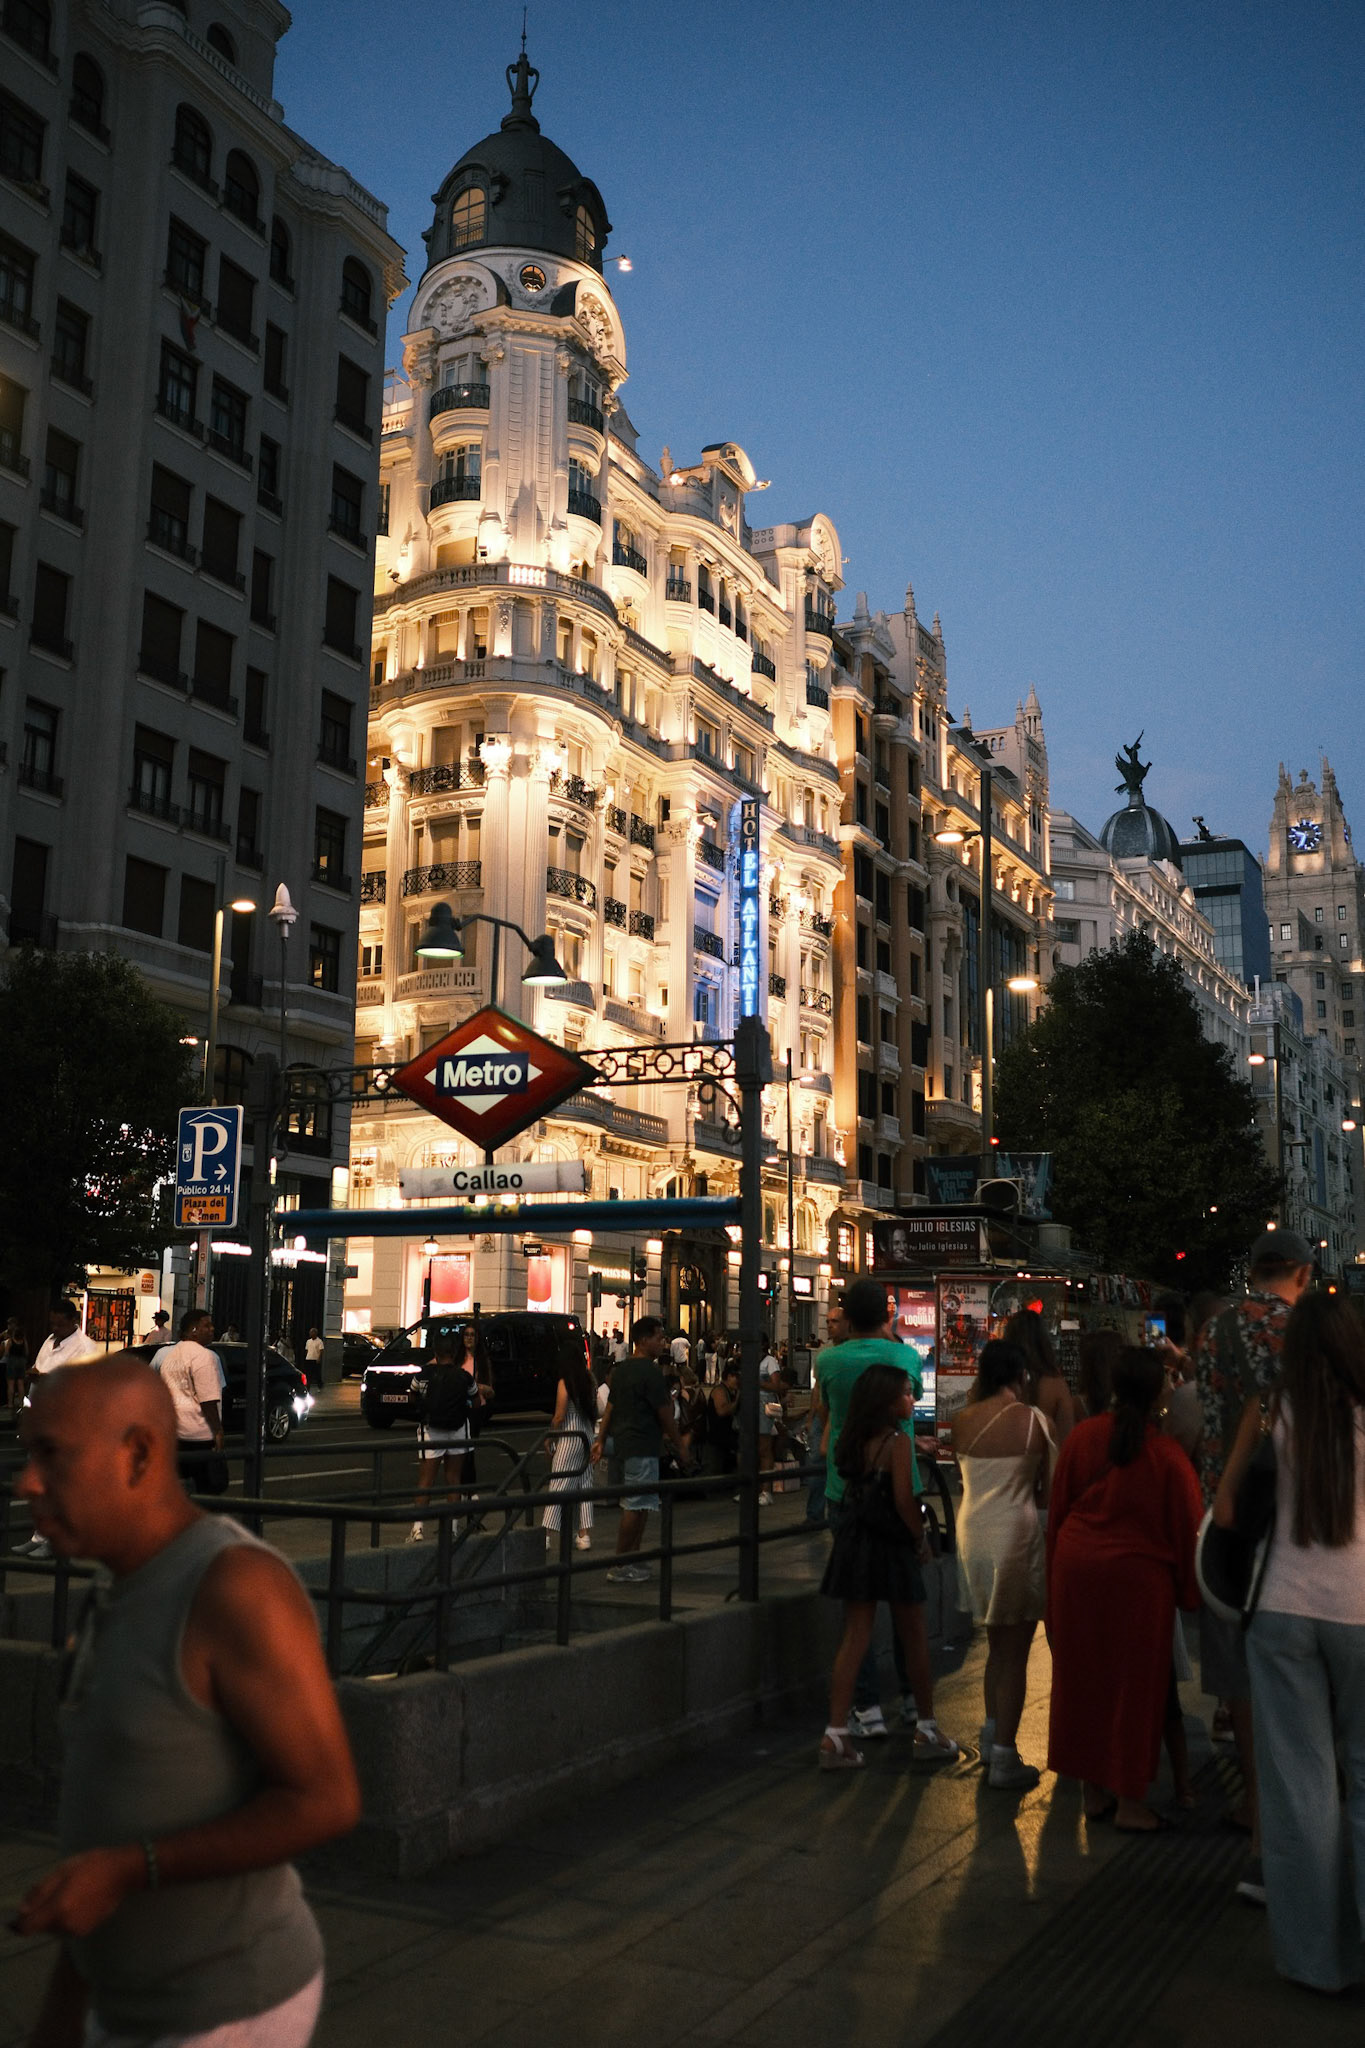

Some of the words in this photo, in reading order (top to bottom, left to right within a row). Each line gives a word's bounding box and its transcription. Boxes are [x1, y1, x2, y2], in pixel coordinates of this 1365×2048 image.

[743, 802, 757, 888] HOTEL
[443, 1060, 522, 1088] Metro
[186, 1122, 228, 1182] P
[453, 1170, 523, 1190] Callao
[177, 1185, 207, 1195] Público
[209, 1185, 221, 1194] 24
[223, 1184, 233, 1194] H.
[184, 1199, 206, 1208] Plaza
[210, 1198, 224, 1207] del
[187, 1211, 219, 1220] Cmen
[909, 1222, 934, 1233] JULIO
[936, 1221, 976, 1232] IGLESIAS
[918, 1243, 936, 1251] Julio
[938, 1242, 968, 1251] Iglesias
